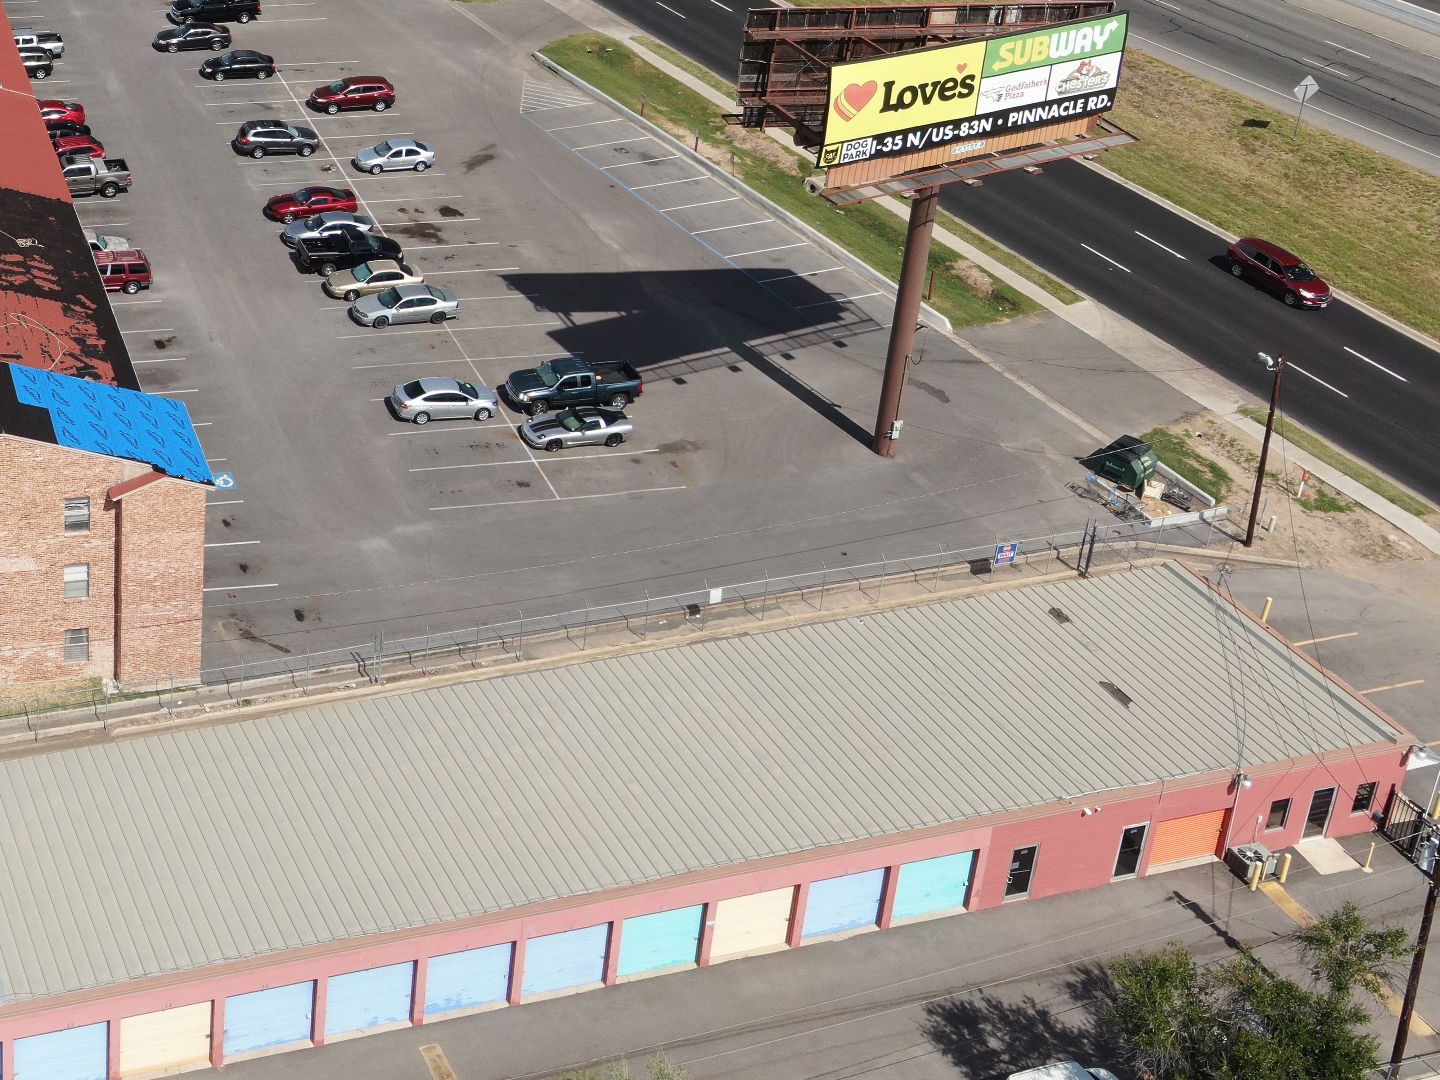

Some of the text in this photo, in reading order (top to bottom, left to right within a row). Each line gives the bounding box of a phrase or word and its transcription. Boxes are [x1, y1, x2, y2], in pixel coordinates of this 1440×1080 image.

[992, 20, 1119, 72] SUBWAY
[1005, 78, 1048, 93] Godfather's
[1004, 91, 1024, 101] Pizza
[870, 95, 1112, 155] I-35 N/US-83N PINNACLE RD.
[845, 140, 868, 151] DOG
[842, 149, 868, 161] PARK
